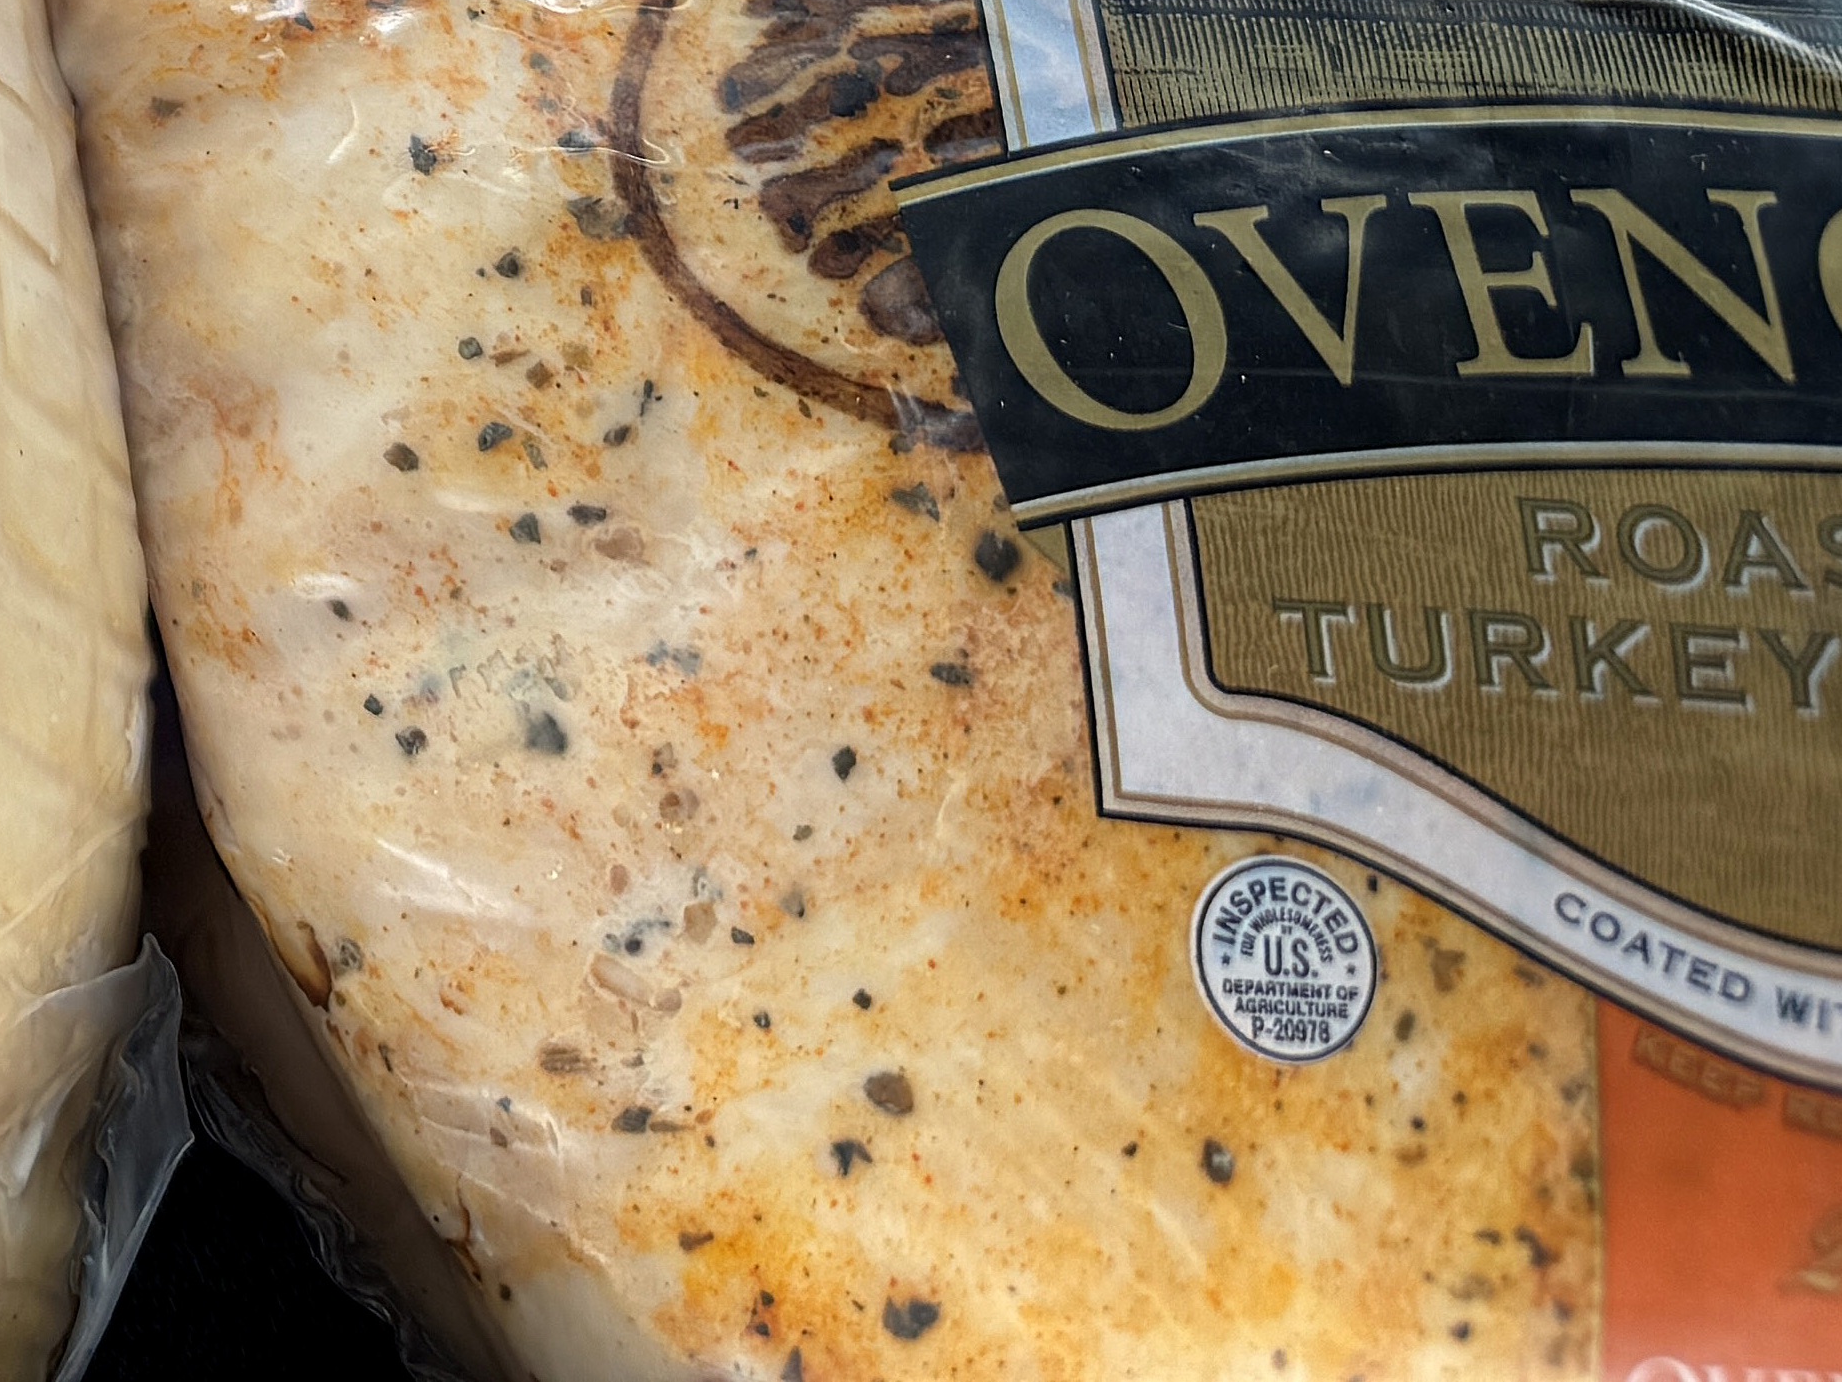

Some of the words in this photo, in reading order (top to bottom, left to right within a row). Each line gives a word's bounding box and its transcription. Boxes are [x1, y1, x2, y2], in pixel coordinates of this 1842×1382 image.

[995, 186, 1842, 431] OVEN
[1272, 596, 1839, 719] TURKEY
[1212, 876, 1359, 955] INSPECTED
[1552, 890, 1754, 1003] COATED
[1264, 934, 1319, 979] U.S.
[1221, 978, 1332, 1000] DEPARTMENT
[1336, 985, 1359, 1002] OF
[1234, 996, 1349, 1020] AGRICULTURE
[1252, 1015, 1331, 1044] P-20978
